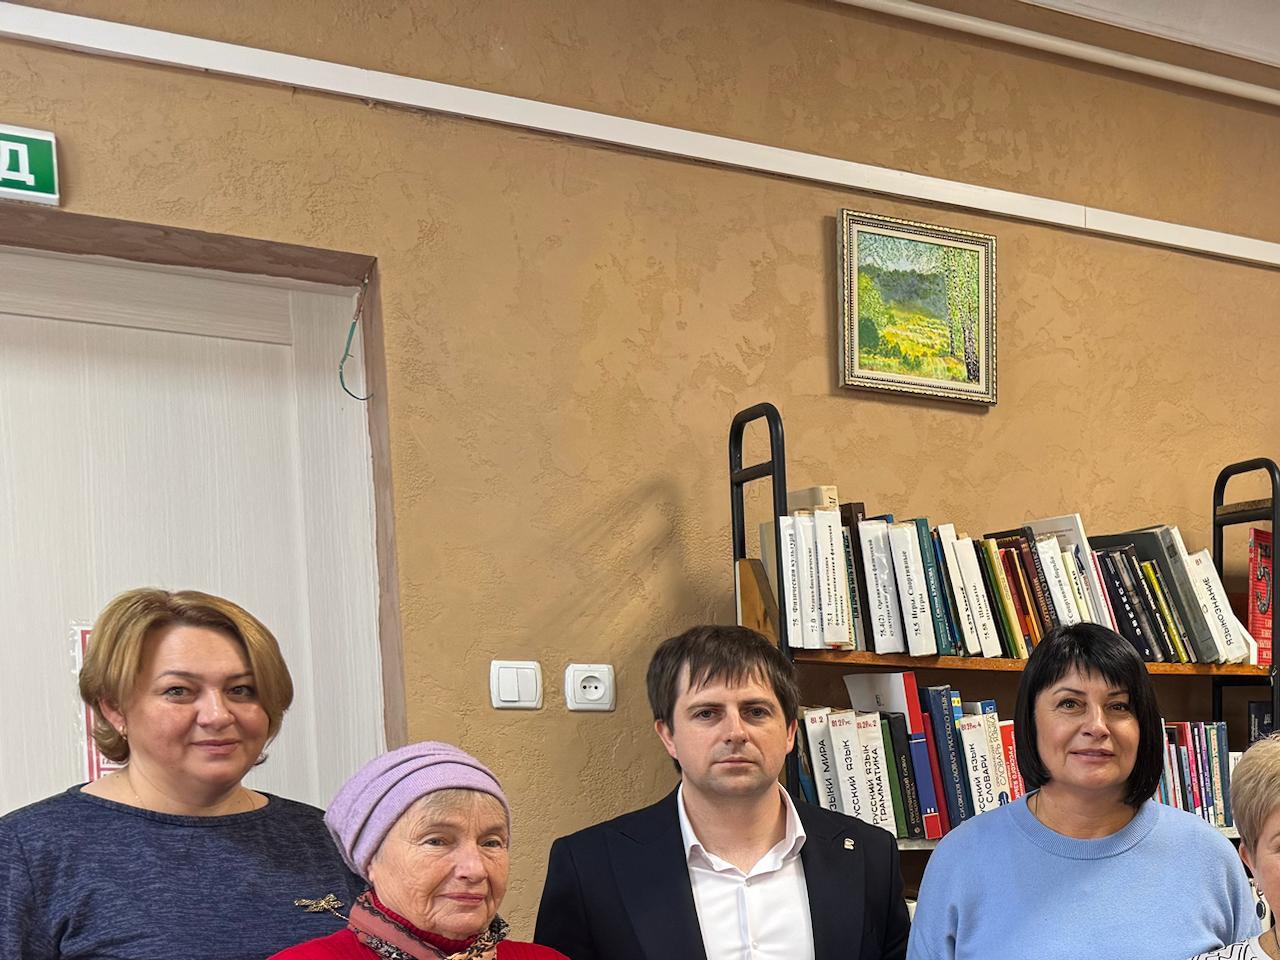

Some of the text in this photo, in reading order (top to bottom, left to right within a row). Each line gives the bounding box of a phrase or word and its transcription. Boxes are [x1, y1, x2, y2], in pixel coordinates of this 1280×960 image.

[1203, 577, 1234, 646] ЯЗЫКОЗНАНИЕ
[819, 739, 837, 811] ЗЫКИ МИРА
[843, 739, 861, 817] УССКИЙ ЯЗЫК
[863, 744, 879, 824] РУССКИЙ ЯЗЫК
[872, 748, 888, 821] ГРАММАТИКА
[969, 743, 985, 813] УССКИЙ ЯЗЫК
[981, 755, 993, 803] СЛОВАРИ
